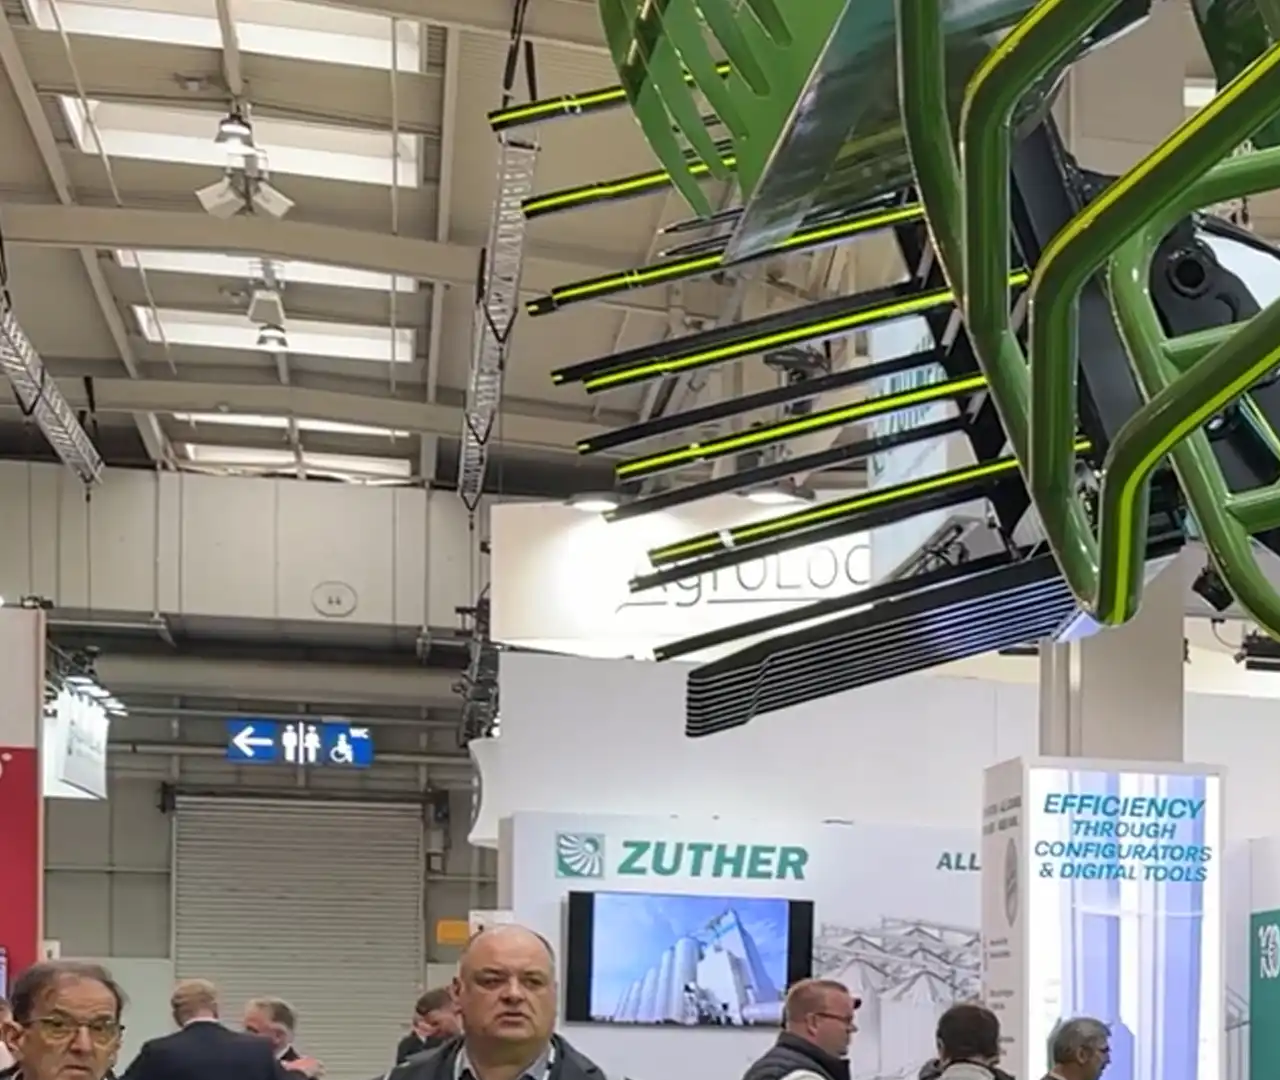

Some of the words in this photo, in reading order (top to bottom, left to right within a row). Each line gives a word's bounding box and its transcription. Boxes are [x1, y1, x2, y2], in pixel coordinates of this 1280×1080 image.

[1043, 792, 1206, 820] EFFICIENCY
[1072, 819, 1177, 840] THROUGH
[616, 840, 810, 881] ZUTHER
[1034, 840, 1213, 862] CONFIGURATORS
[1038, 862, 1054, 878] &
[1059, 862, 1137, 880] DIGITAL
[1143, 864, 1209, 882] TOOLS
